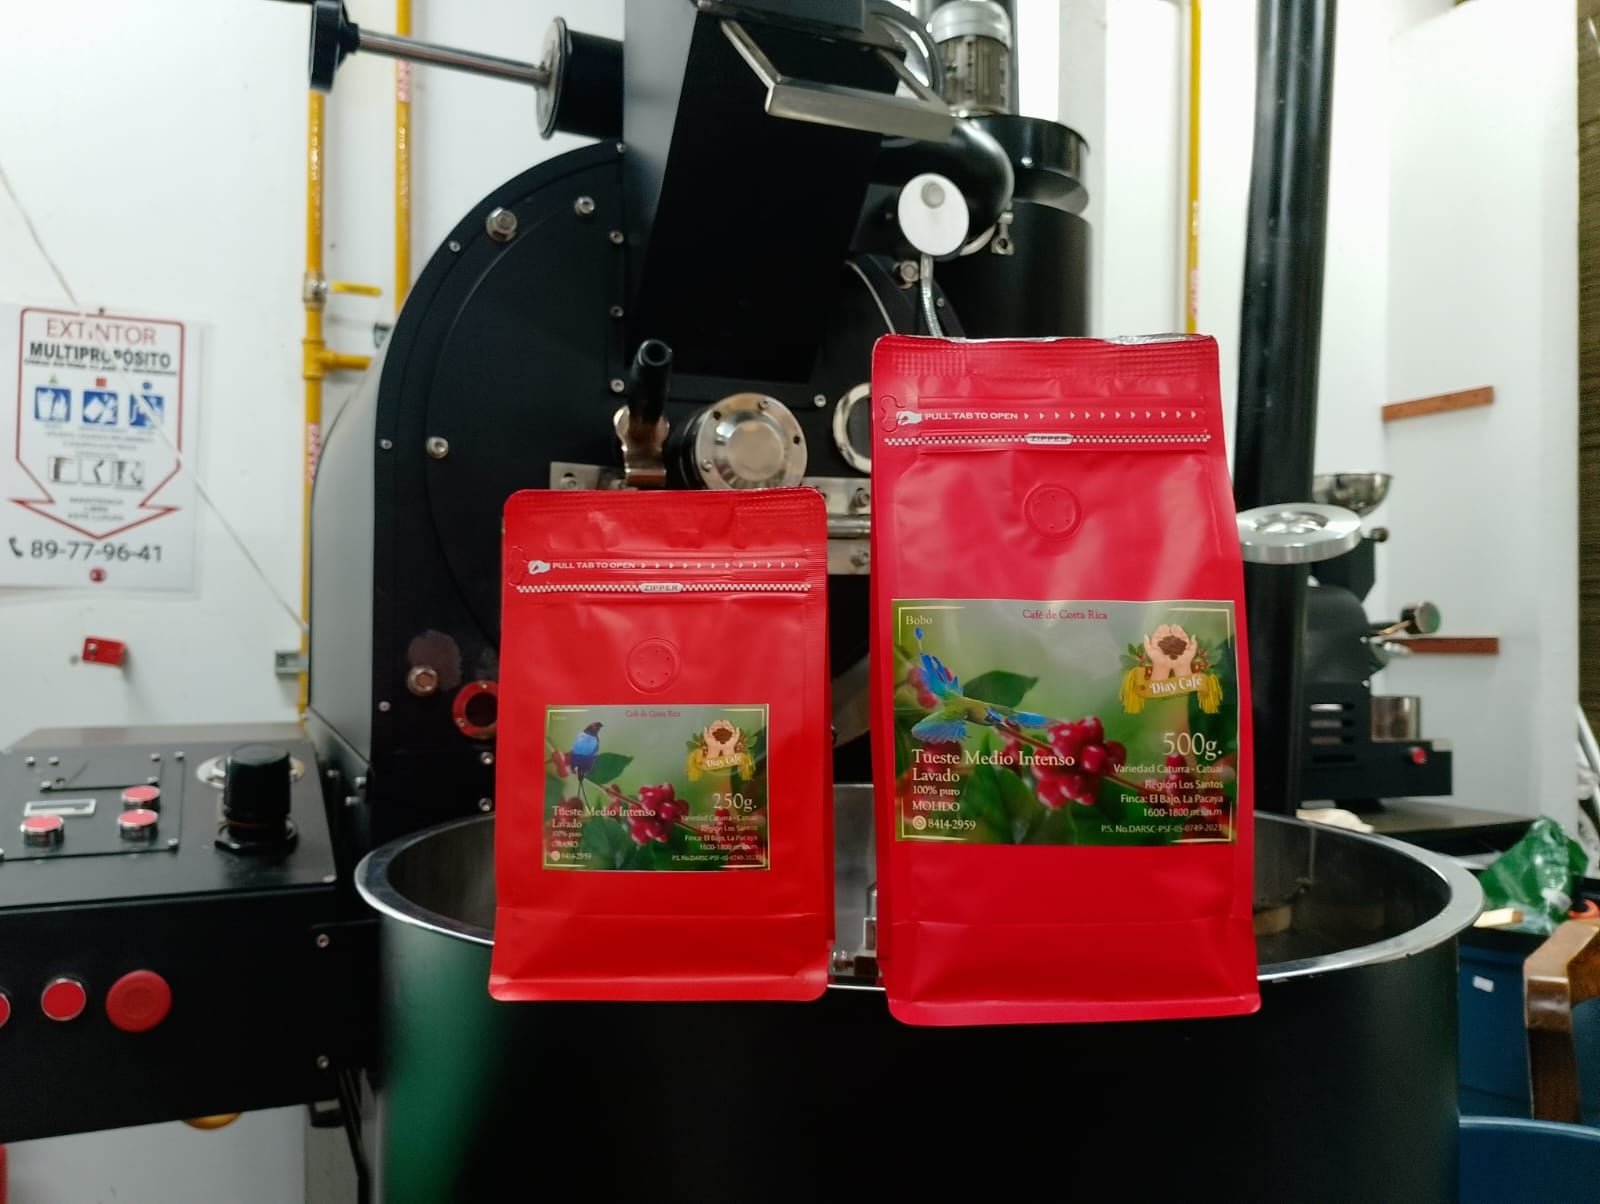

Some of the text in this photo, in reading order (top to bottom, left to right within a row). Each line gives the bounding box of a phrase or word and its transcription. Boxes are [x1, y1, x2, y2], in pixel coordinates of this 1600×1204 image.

[924, 412, 1018, 420] PULL TAB TO OPEN
[30, 539, 163, 562] 89-77-96-41
[552, 561, 636, 569] PULL TAB TO OPEN
[906, 615, 933, 625] Bobo
[1022, 609, 1108, 620] Café de Costa Rica
[1162, 732, 1223, 761] 500g.
[911, 748, 1076, 766] Tueste Medio Intenso
[912, 767, 960, 782] Lavado
[1113, 763, 1155, 774] Variedad
[1157, 764, 1190, 774] Caturra
[913, 785, 960, 797] 100% puro
[1179, 780, 1194, 790] Los
[1195, 780, 1224, 790] Santos
[712, 792, 758, 813] 250g.
[912, 800, 960, 812] MOLIDO
[1120, 794, 1149, 804] Finca:
[1149, 794, 1159, 804] El
[1183, 795, 1194, 804] La
[1195, 794, 1224, 806] Pacaya
[551, 805, 656, 817] Tueste Medio Intenso
[1143, 808, 1189, 818] 1600-1800
[551, 818, 582, 829] Lavado
[927, 819, 977, 831] 8414-2959
